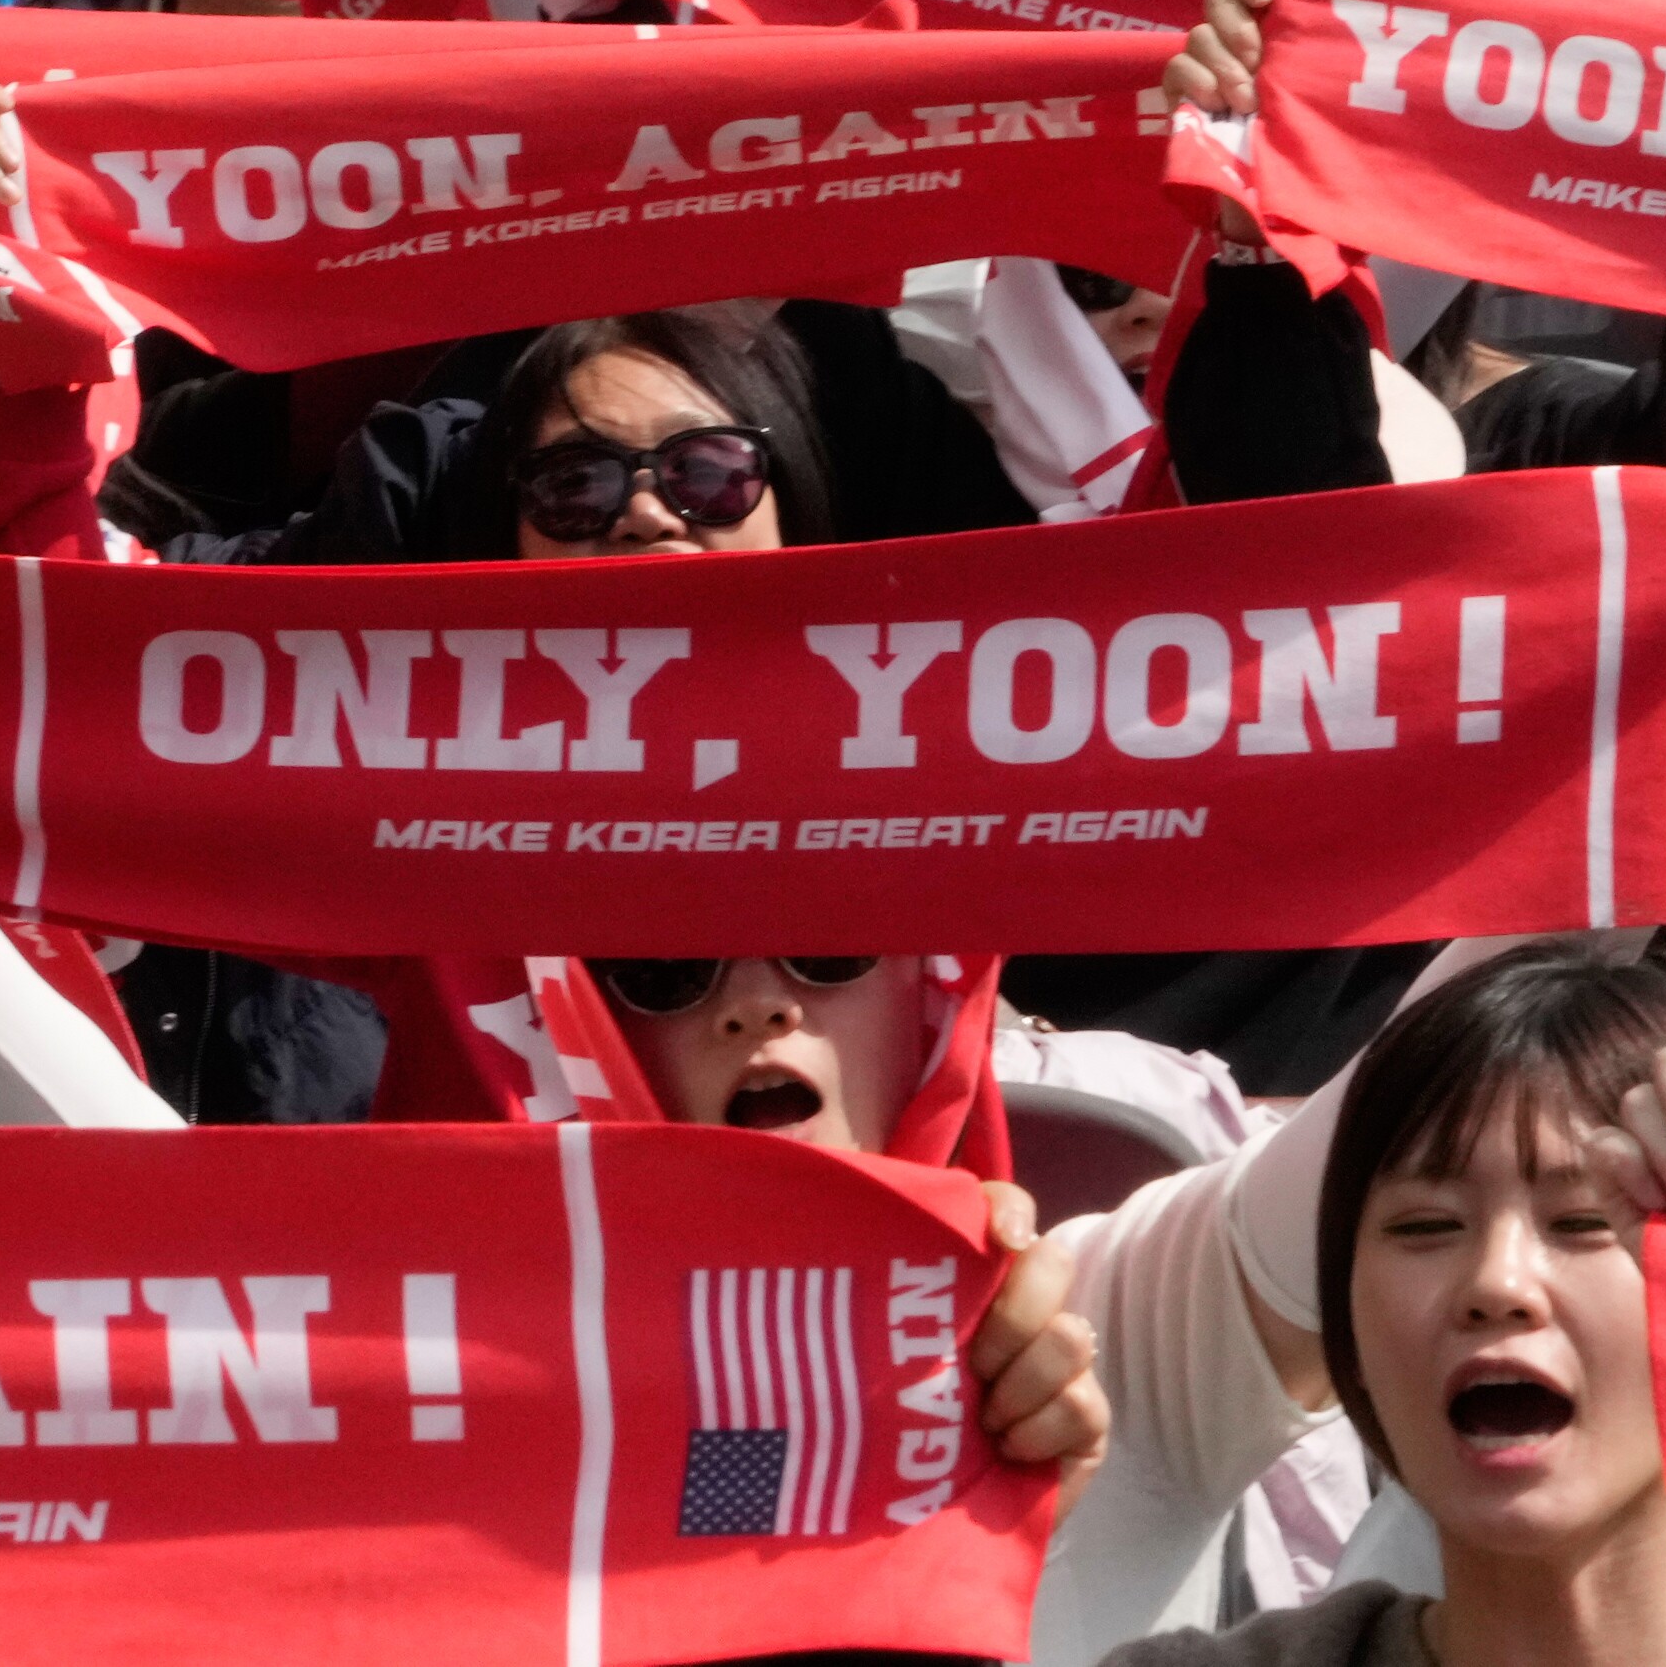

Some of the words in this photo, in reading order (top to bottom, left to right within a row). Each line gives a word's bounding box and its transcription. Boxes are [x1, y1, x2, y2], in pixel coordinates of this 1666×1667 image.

[91, 133, 564, 251] YOON,
[606, 94, 1096, 193] AGAIN
[316, 228, 453, 273] MAKE
[464, 203, 631, 249] KOREA
[641, 183, 803, 221] GREAT
[815, 167, 962, 206] AGAIN
[137, 627, 739, 792] ONLY,
[805, 602, 1401, 771] YOON
[373, 819, 551, 852] MAKE
[564, 818, 781, 853] KOREA
[794, 814, 1005, 852] GREAT
[1018, 807, 1210, 845] AGAIN
[884, 1255, 958, 1528] AGAIN
